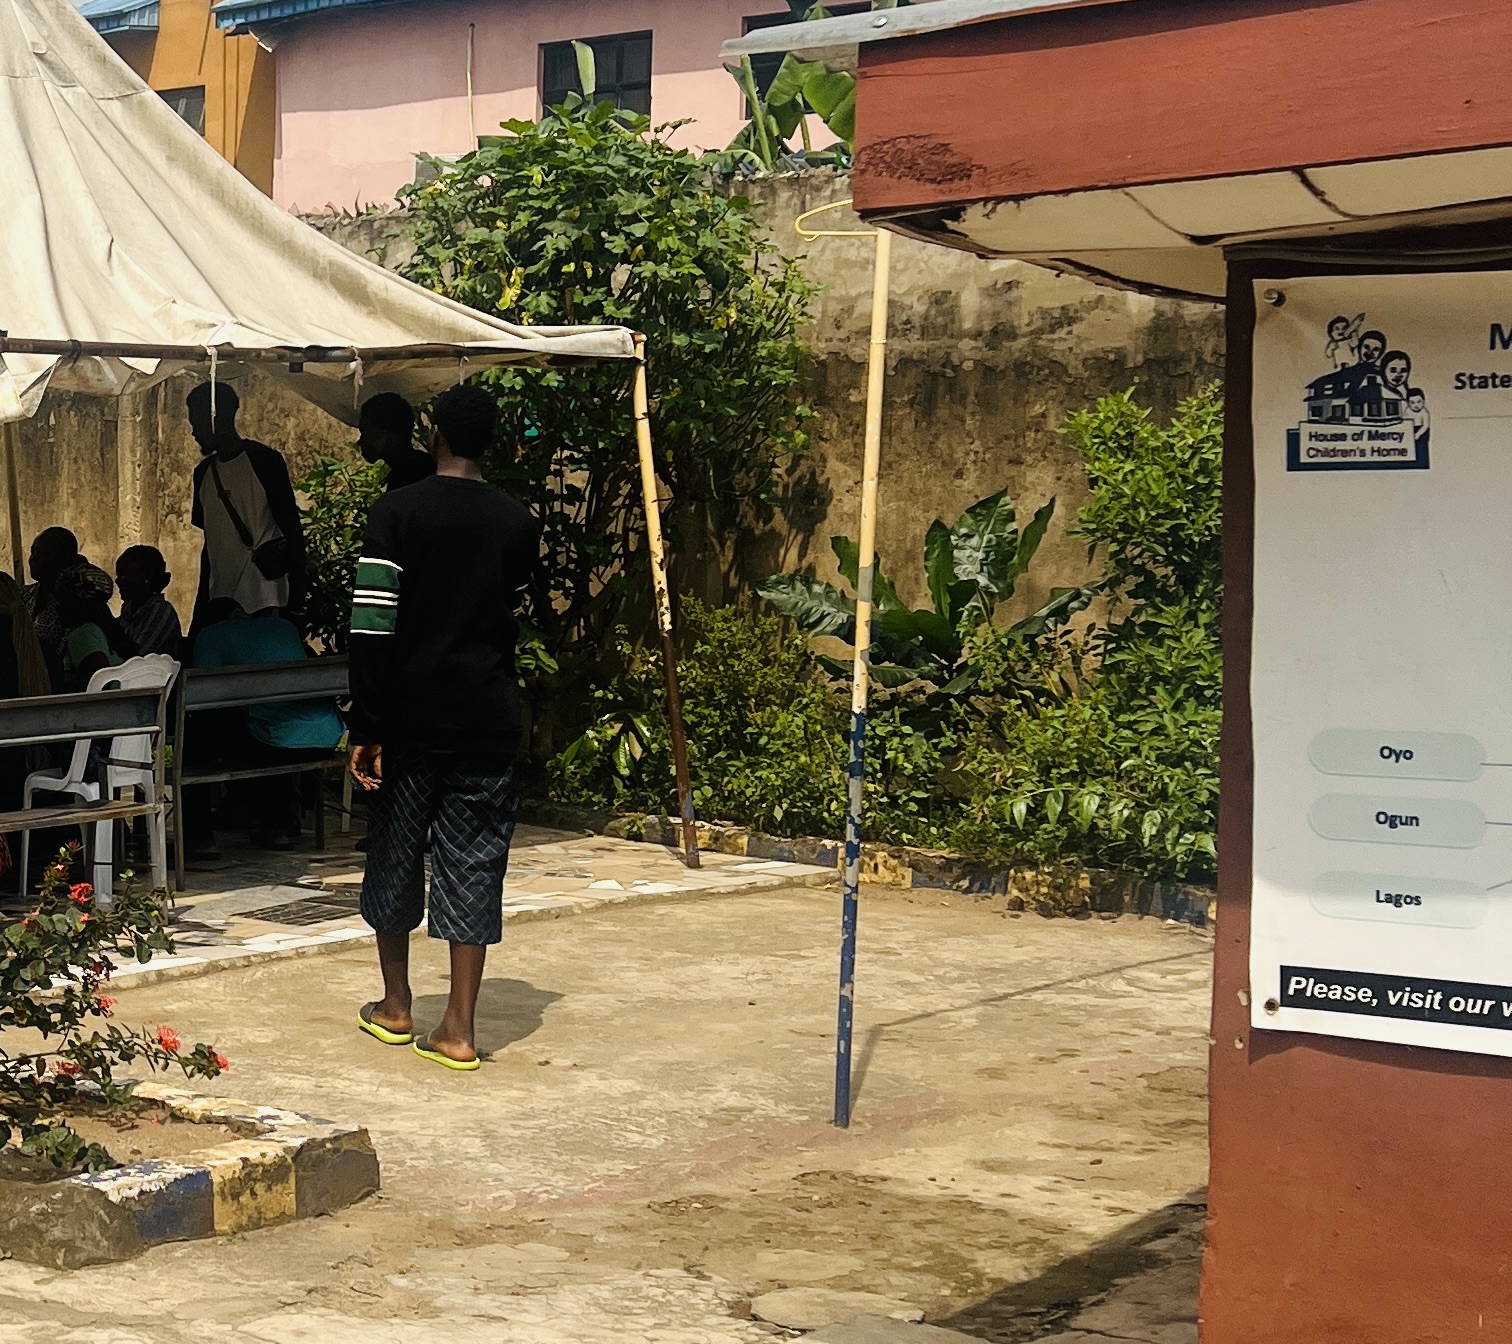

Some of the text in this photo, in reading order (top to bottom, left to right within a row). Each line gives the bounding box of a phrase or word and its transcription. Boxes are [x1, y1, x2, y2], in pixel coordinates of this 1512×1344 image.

[1309, 430, 1405, 443] House of Mercy
[1307, 446, 1408, 458] Children's Home
[1379, 745, 1414, 763] Oyo
[1375, 811, 1420, 829] Ogun
[1375, 889, 1422, 907] Lagos
[1287, 976, 1378, 1006] Please,
[1387, 986, 1444, 1010] visit
[1448, 995, 1496, 1015] our
